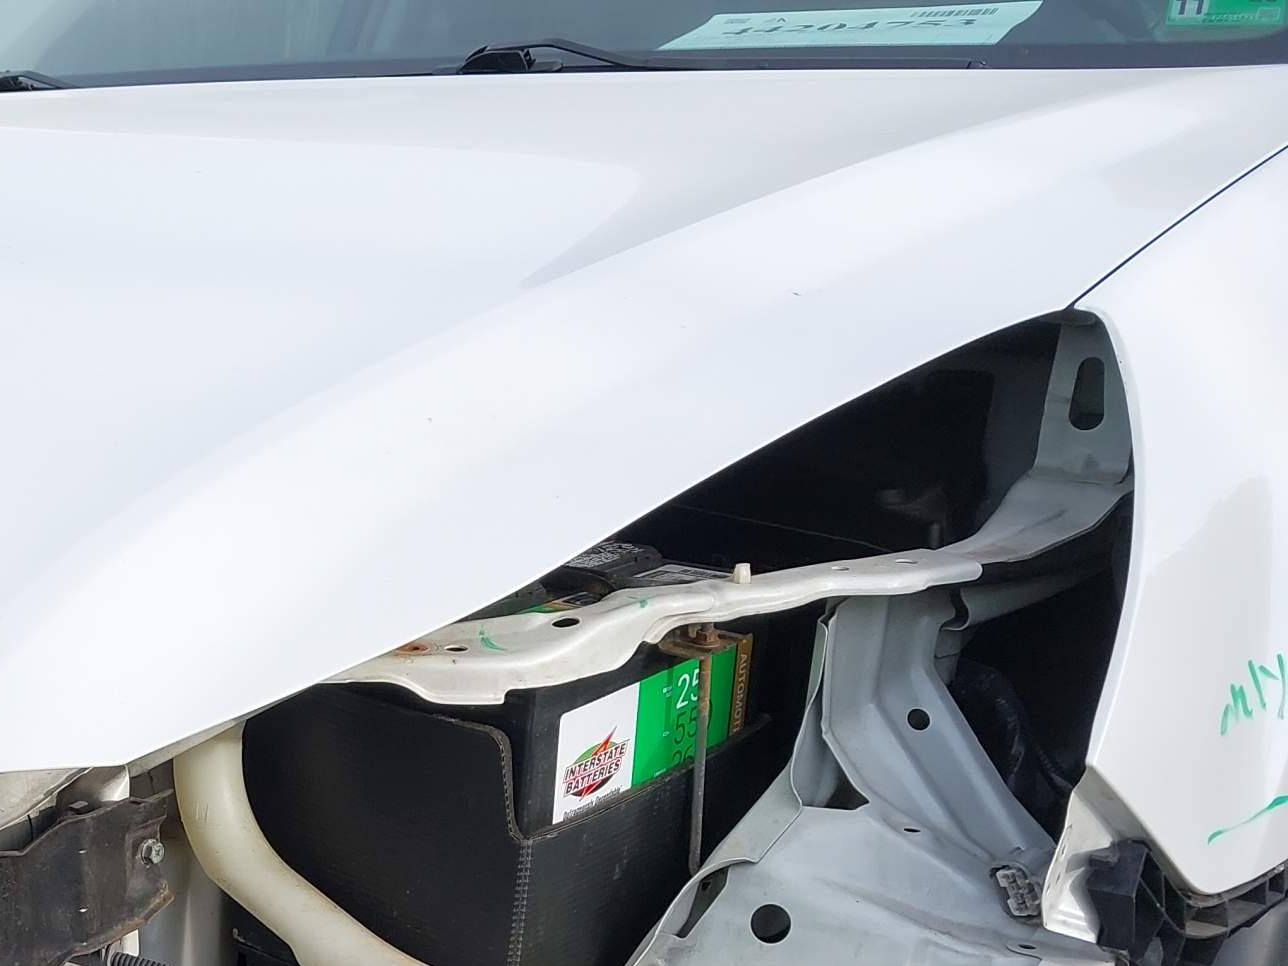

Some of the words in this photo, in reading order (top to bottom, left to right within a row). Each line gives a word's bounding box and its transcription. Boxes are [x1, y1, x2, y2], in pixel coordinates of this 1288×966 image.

[721, 18, 977, 36] 44204753
[564, 742, 627, 781] INTERSTATE
[566, 758, 621, 795] BATTERIES
